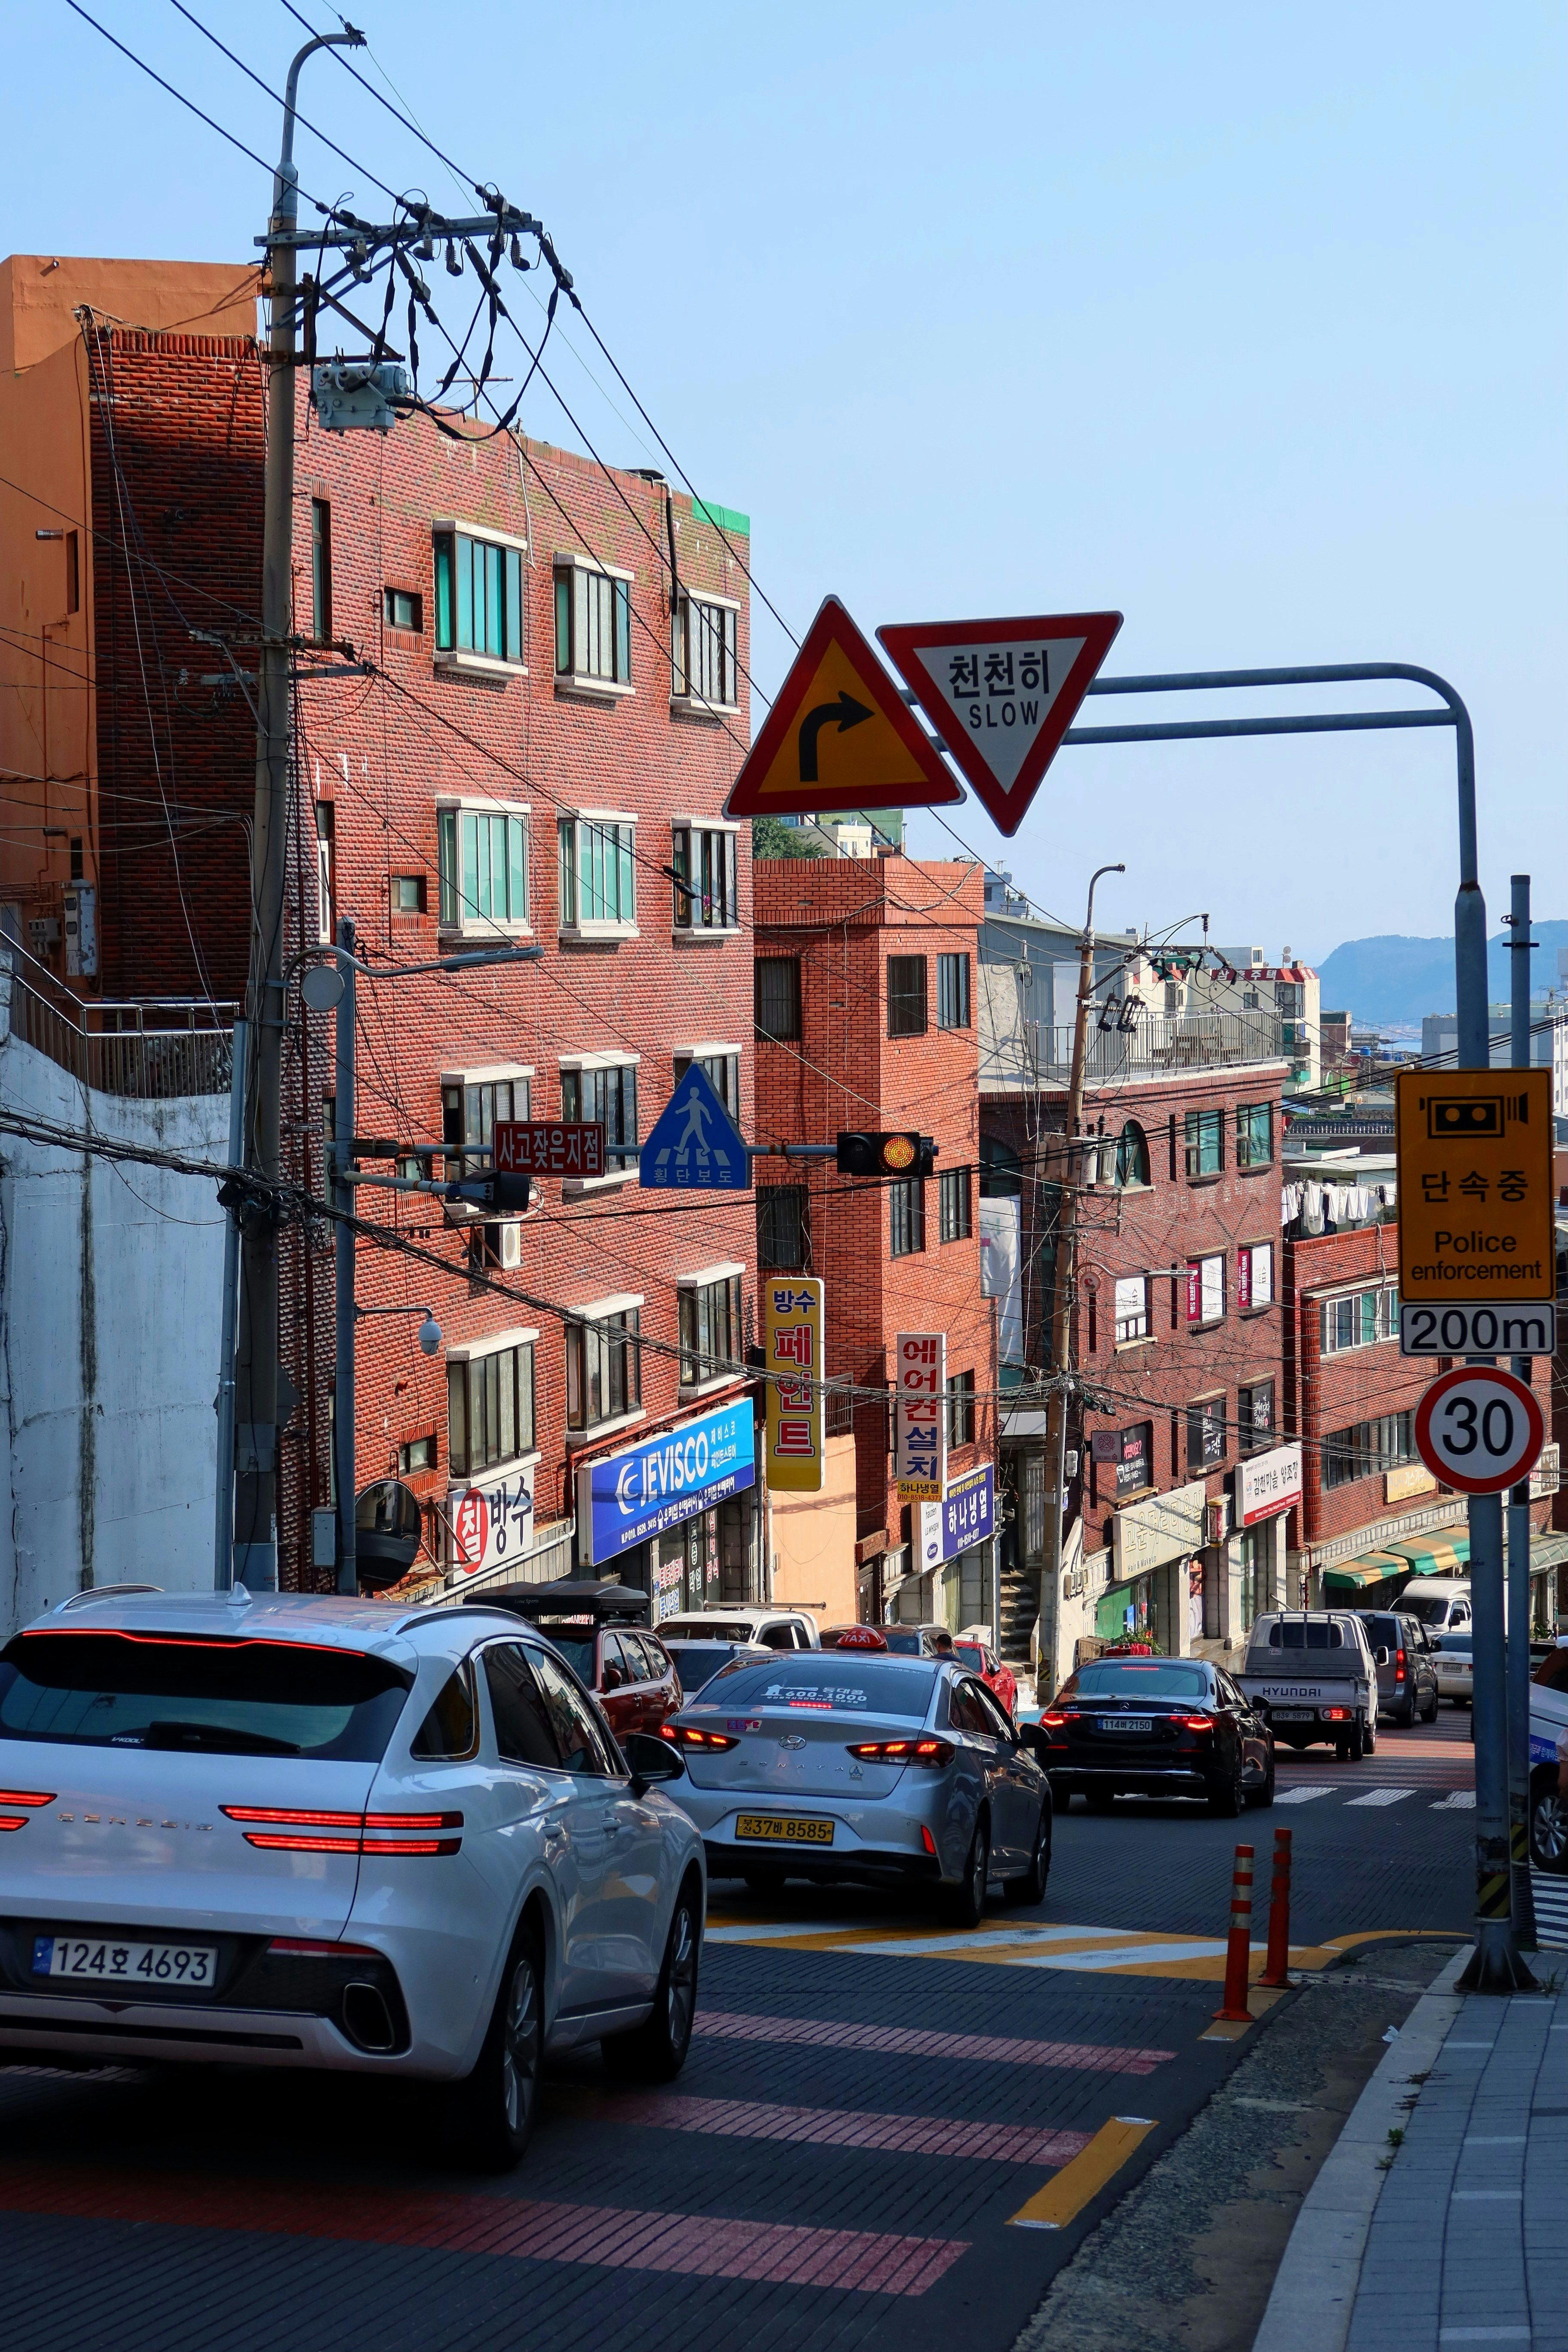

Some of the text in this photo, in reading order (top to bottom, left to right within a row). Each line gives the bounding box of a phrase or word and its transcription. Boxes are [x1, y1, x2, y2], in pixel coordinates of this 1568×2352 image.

[949, 650, 1050, 698] 천천히
[969, 700, 1038, 729] SLOW
[499, 1128, 598, 1170] 사고잦은지점
[654, 1167, 733, 1183] 횡단보도
[1421, 1170, 1528, 1202] 단속중
[1434, 1231, 1517, 1253] Police
[1412, 1260, 1542, 1280] enforcement
[774, 1290, 815, 1314] 방수
[1411, 1310, 1546, 1350] 200m
[775, 1324, 815, 1457] 페인트
[1442, 1397, 1513, 1456] 30
[641, 1432, 708, 1507] JEVISCO
[900, 1483, 939, 1494] 하나냉열
[490, 1475, 532, 1555] 방수
[948, 1487, 987, 1535] 하나냉열
[648, 1517, 656, 1530] 3415
[1128, 1563, 1136, 1573] Hair
[1141, 1557, 1157, 1567] Makeup
[845, 1635, 870, 1644] TAXI
[785, 1691, 867, 1701] 600-1000
[1263, 1687, 1321, 1697] HYUNDAI
[1129, 1720, 1150, 1731] 2150
[1292, 1712, 1310, 1721] 5879
[739, 1761, 844, 1771] SONATA
[56, 1813, 214, 1831] GENESIS
[743, 1819, 827, 1839] 부산 37바 8585
[58, 1942, 208, 1981] 124호 4693
